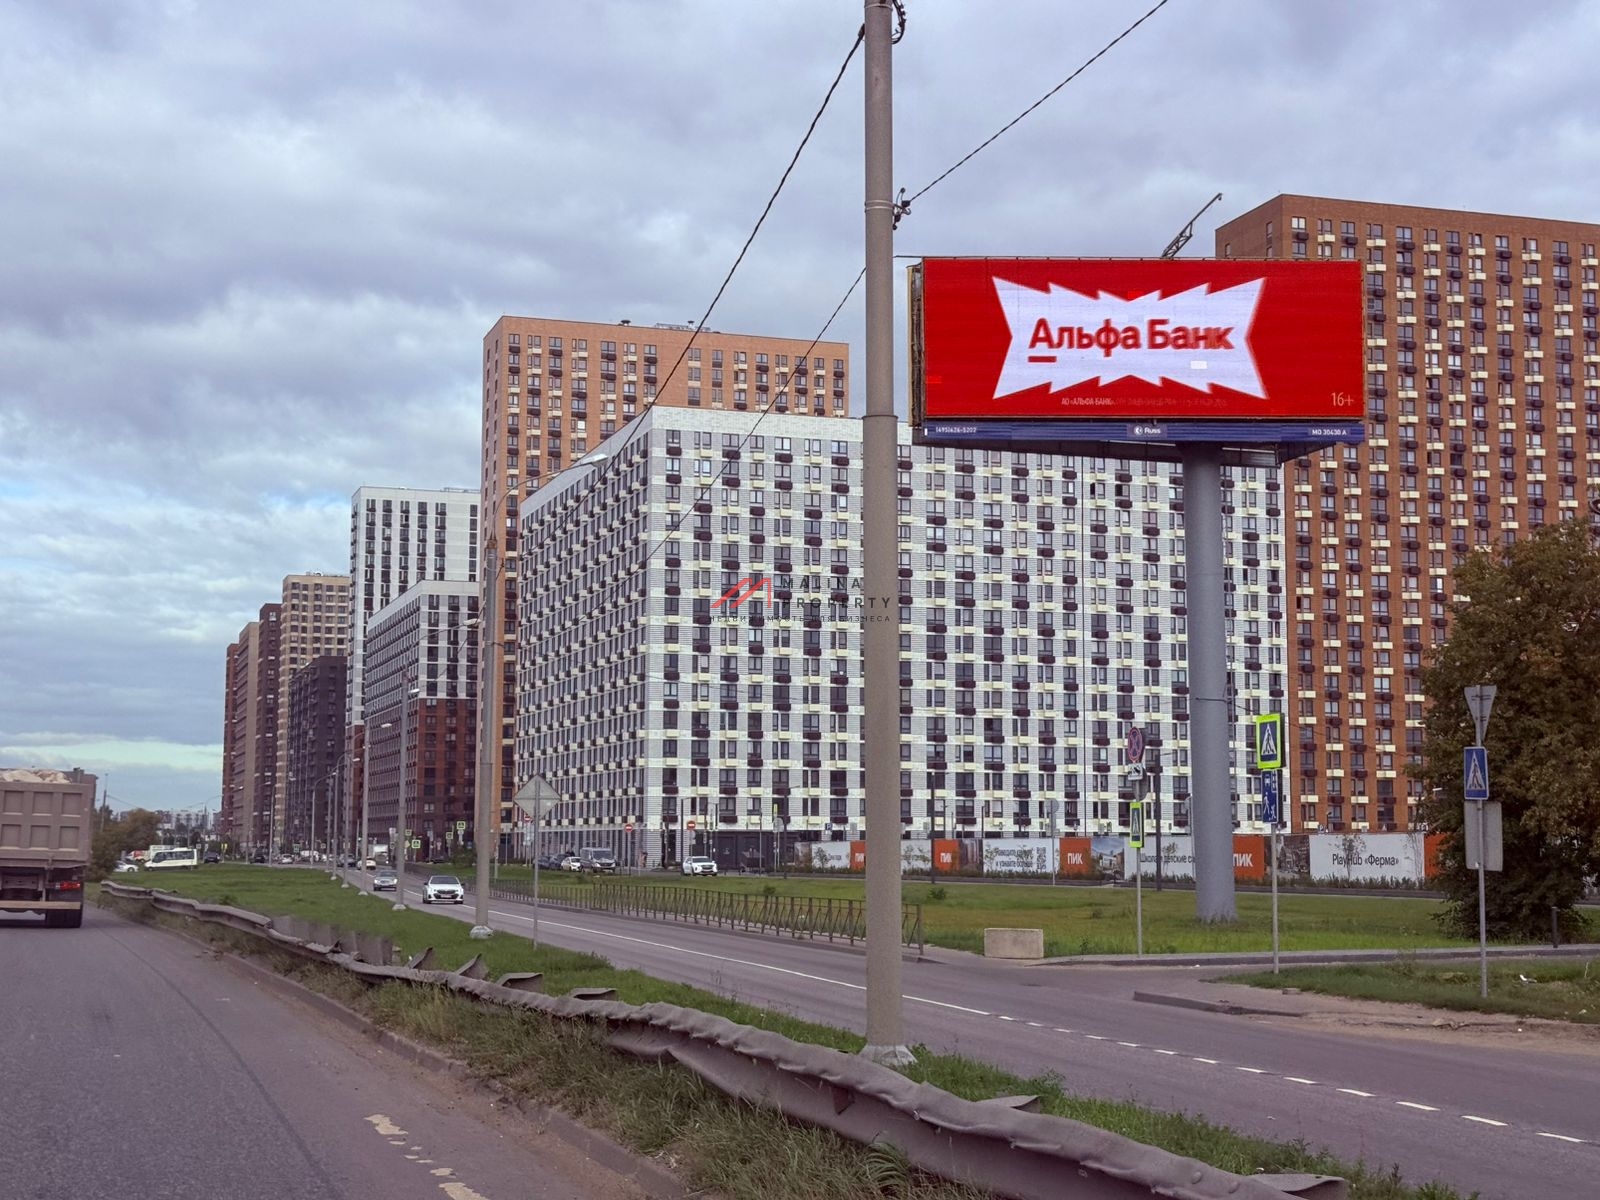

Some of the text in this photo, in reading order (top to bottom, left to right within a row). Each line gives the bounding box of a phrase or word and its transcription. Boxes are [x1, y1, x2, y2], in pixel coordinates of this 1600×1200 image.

[1028, 318, 1235, 357] Альфа Банк
[1331, 392, 1354, 406] 16+
[940, 852, 953, 863] ПИК
[1067, 853, 1083, 865] ПИК
[1232, 853, 1254, 867] ПИК
[1364, 853, 1400, 868] «Ферма»
